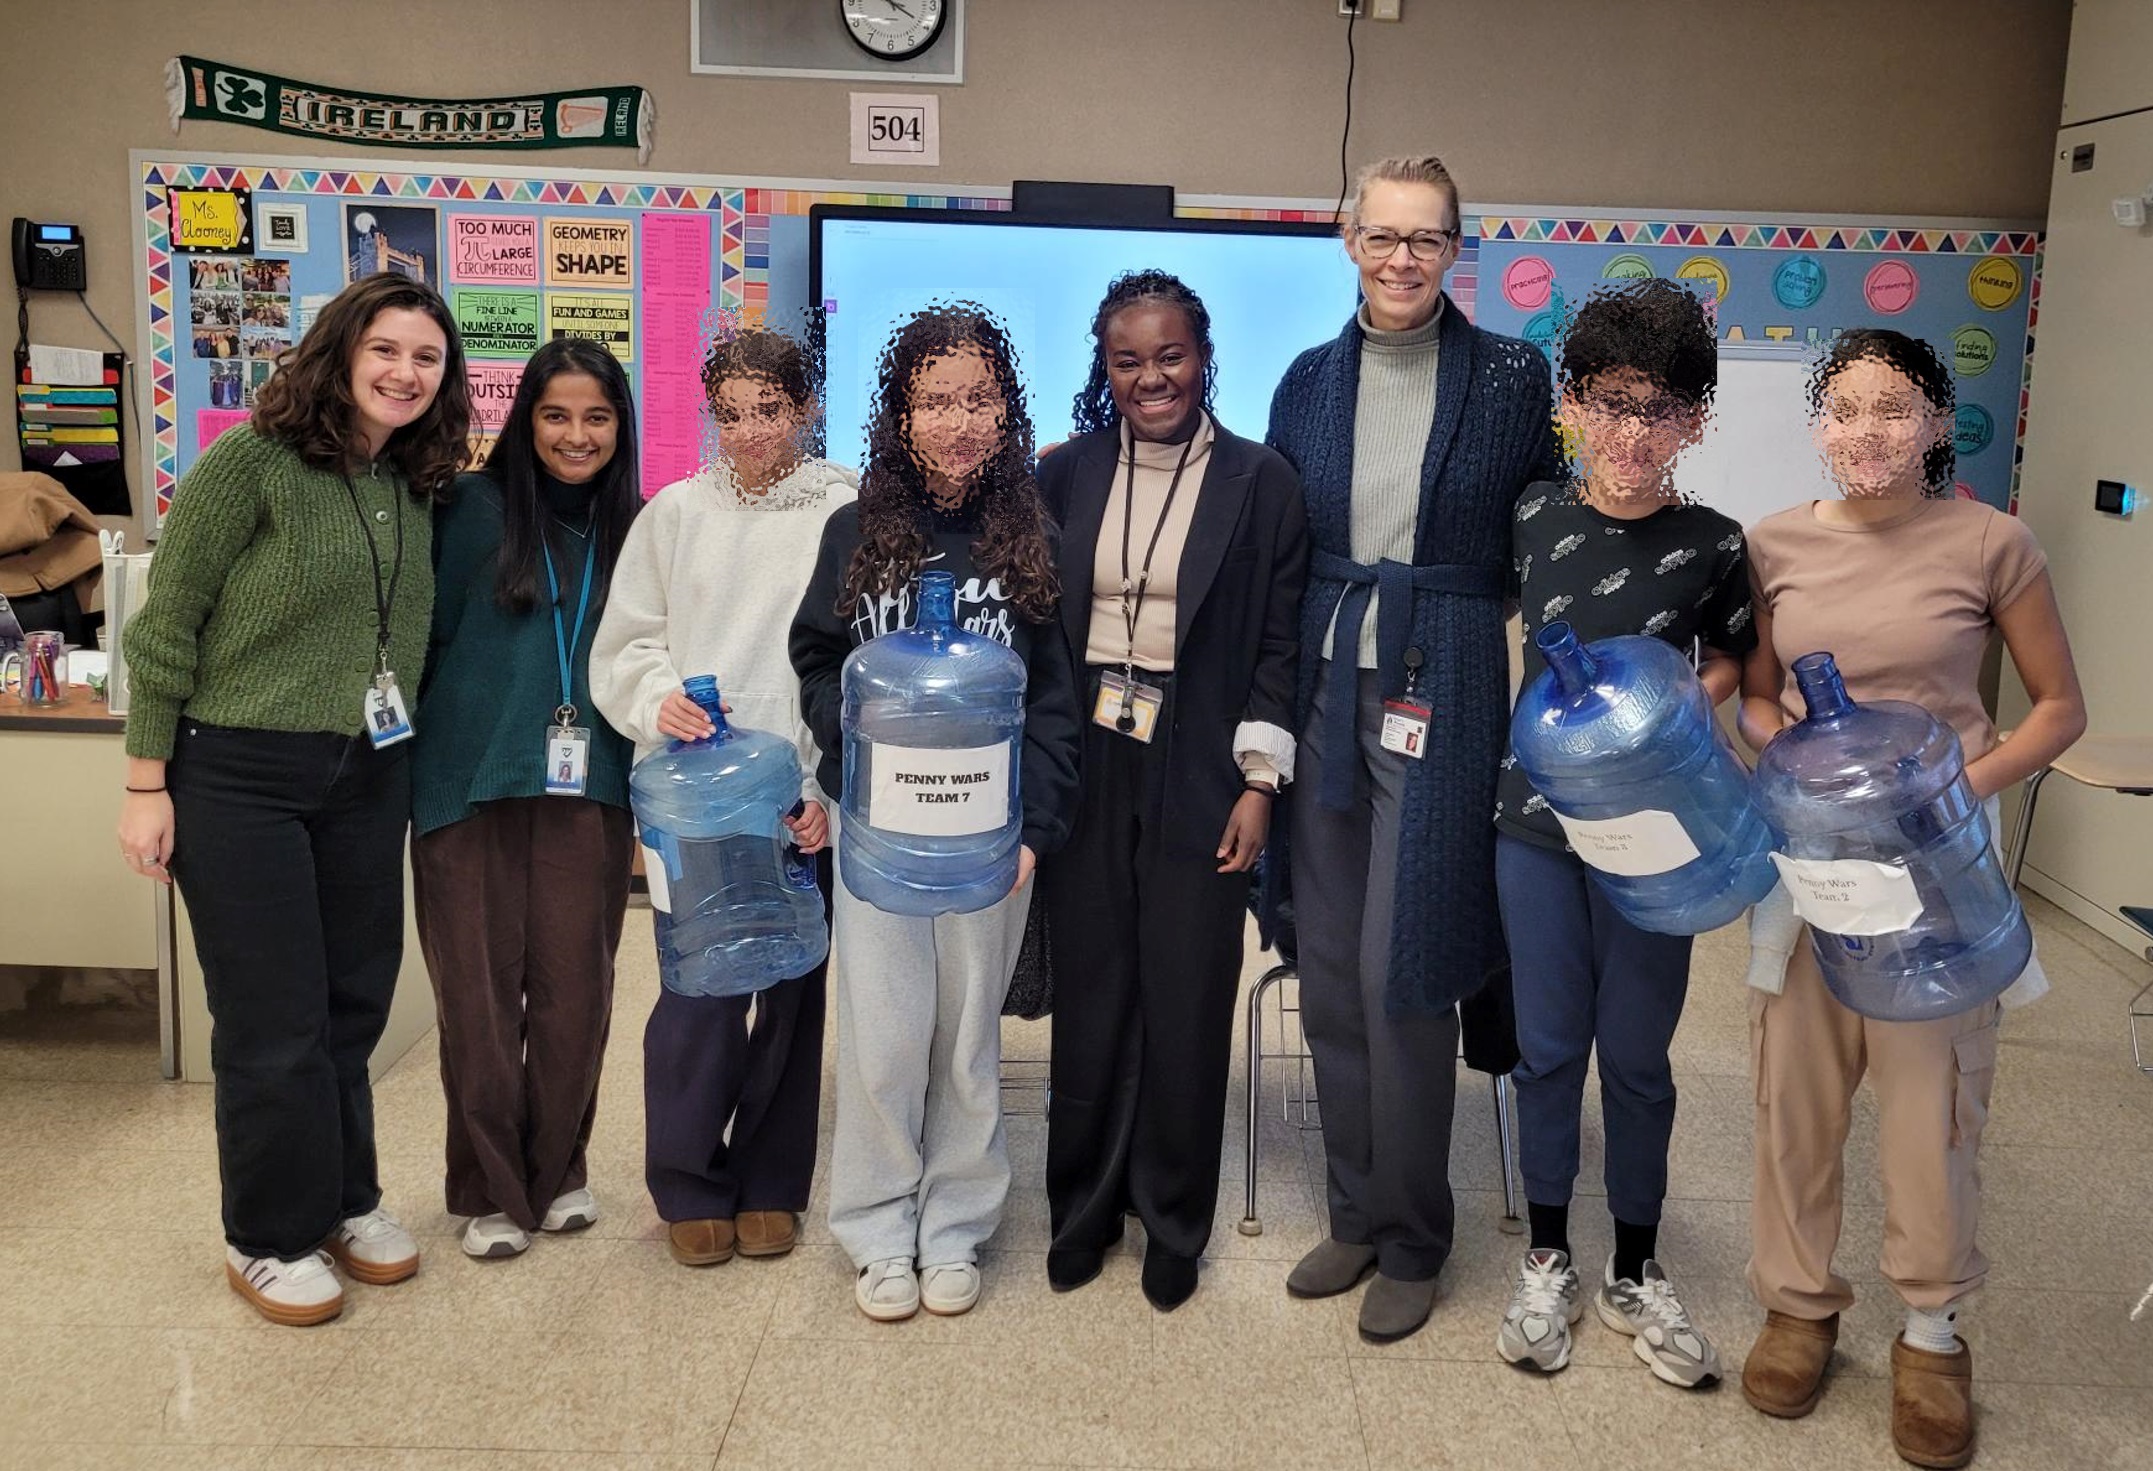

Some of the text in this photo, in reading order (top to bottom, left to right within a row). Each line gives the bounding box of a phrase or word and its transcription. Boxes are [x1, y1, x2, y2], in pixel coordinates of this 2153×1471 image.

[888, 40, 894, 51] 6
[907, 35, 914, 46] 5
[307, 101, 516, 131] IRELAND
[615, 97, 631, 137] IRELAND
[871, 116, 921, 142] 504
[192, 200, 219, 220] Ms.
[181, 218, 232, 245] Clooney
[458, 222, 532, 236] TOO MUCH
[553, 226, 627, 242] GEOMETRY
[558, 240, 623, 254] KEEPS YOU IN
[492, 247, 533, 261] LARGE
[457, 262, 533, 277] CIRCUMFERENCE
[557, 253, 627, 276] SHAPE
[1979, 275, 2015, 289] thinking
[478, 296, 499, 306] THERE
[476, 306, 518, 315] FINE LINE
[553, 307, 627, 319] FUN AND GAMES
[462, 321, 535, 334] NUMERATOR
[564, 329, 617, 341] DIVIDES BY
[461, 338, 536, 350] DENOMINATOR
[1955, 339, 1988, 352] finding
[1955, 350, 1989, 361] olutions
[483, 370, 515, 383] THINK
[467, 383, 520, 399] OUTSI
[1955, 432, 1982, 444] deas
[895, 771, 990, 785] PENNY WARS
[915, 792, 971, 803] TEAM 7
[1604, 833, 1633, 842] Wars
[1827, 879, 1858, 888] Wars
